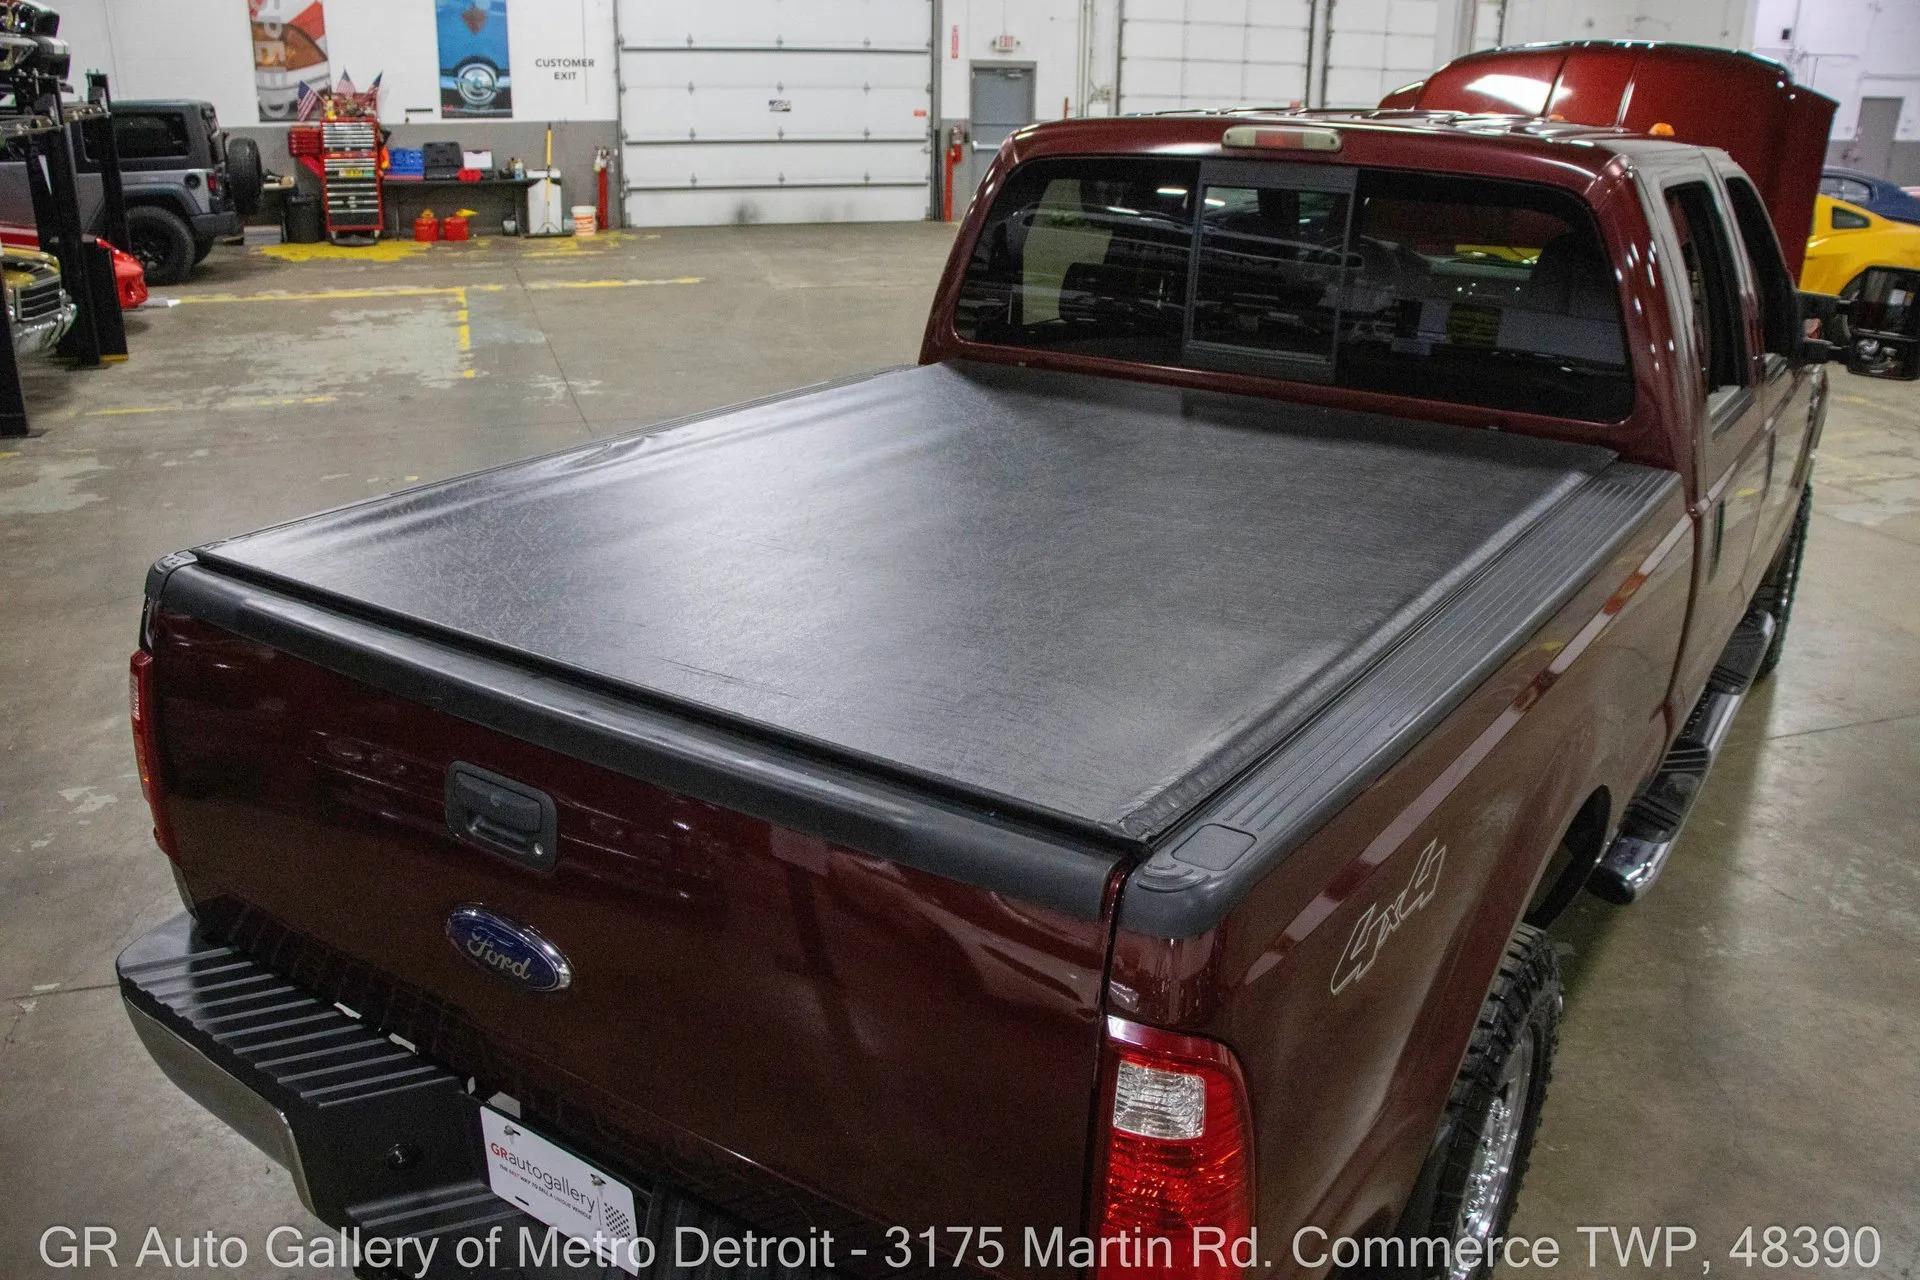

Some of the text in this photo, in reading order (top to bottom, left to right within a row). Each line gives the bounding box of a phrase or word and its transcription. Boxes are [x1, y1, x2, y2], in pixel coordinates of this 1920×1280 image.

[535, 58, 595, 67] CUSTOMER
[554, 71, 577, 80] EXIT
[466, 931, 532, 980] Ford
